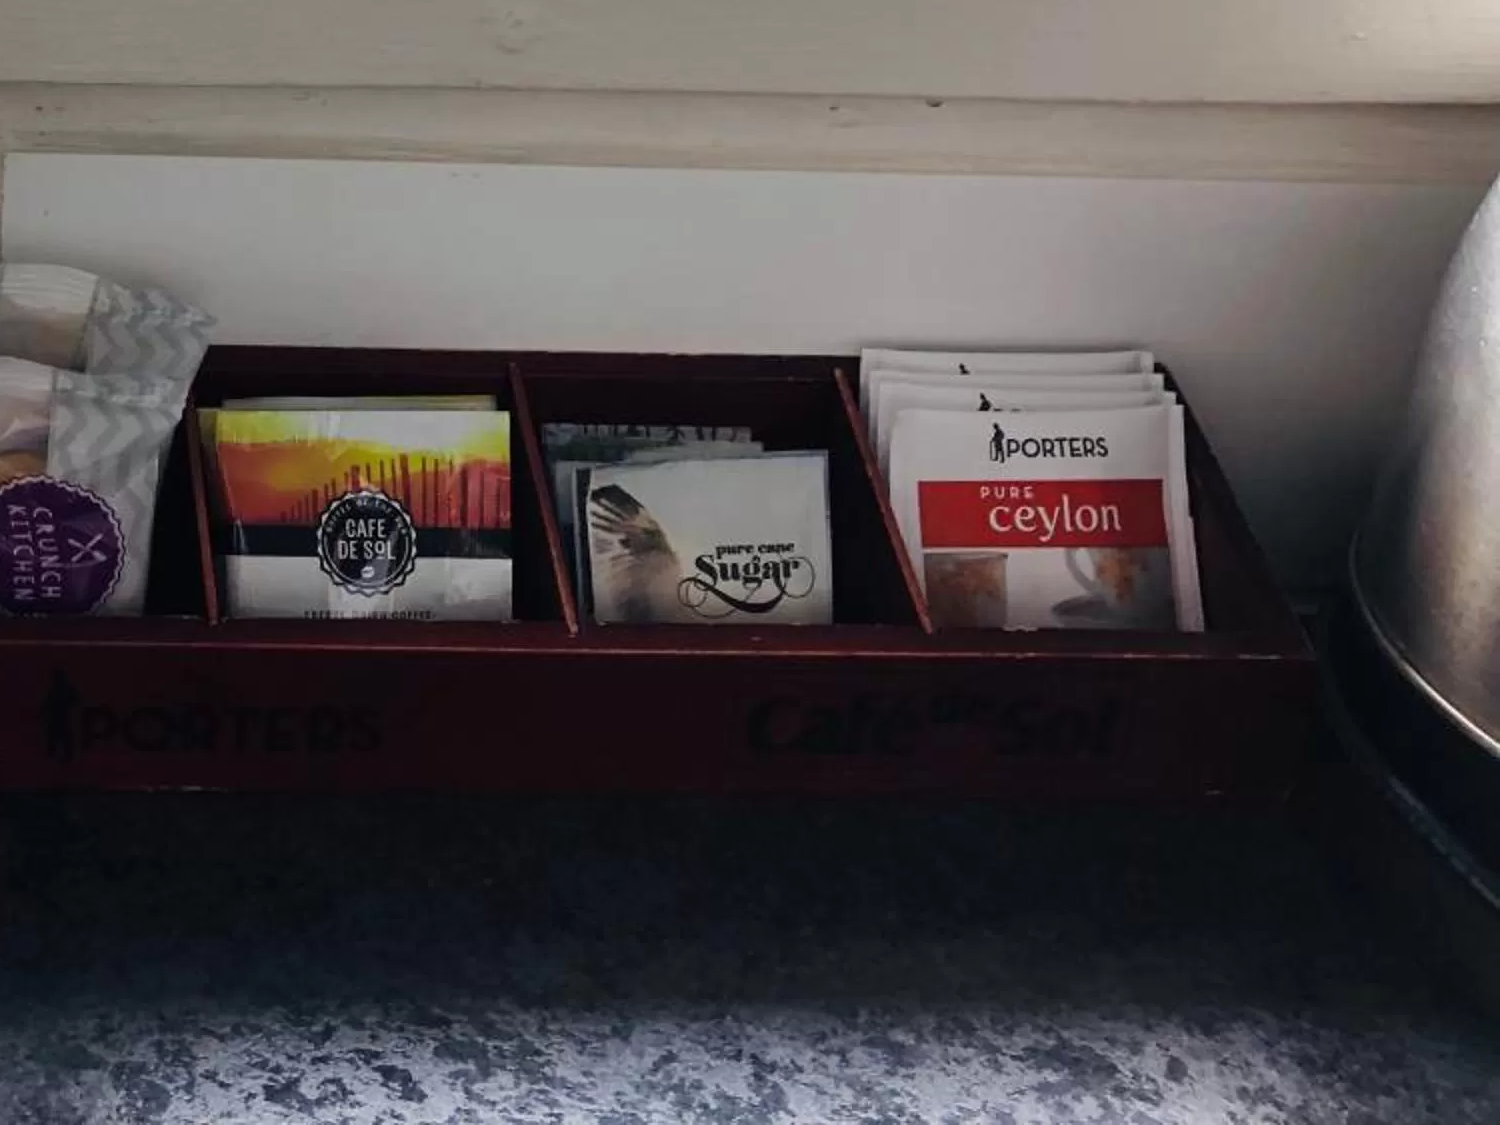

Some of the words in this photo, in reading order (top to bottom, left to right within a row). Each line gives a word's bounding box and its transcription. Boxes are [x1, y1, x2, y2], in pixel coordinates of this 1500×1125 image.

[1006, 436, 1110, 459] PORTERS
[979, 485, 1035, 500] PURE
[345, 517, 387, 539] CAFE
[987, 493, 1122, 543] ceylon
[6, 504, 38, 601] KITCHEN
[32, 506, 63, 600] CRUNCH
[337, 540, 359, 560] DE
[715, 544, 755, 560] pure
[757, 542, 795, 554] cane
[679, 554, 814, 603] Sugar
[77, 704, 386, 754] PORTERS
